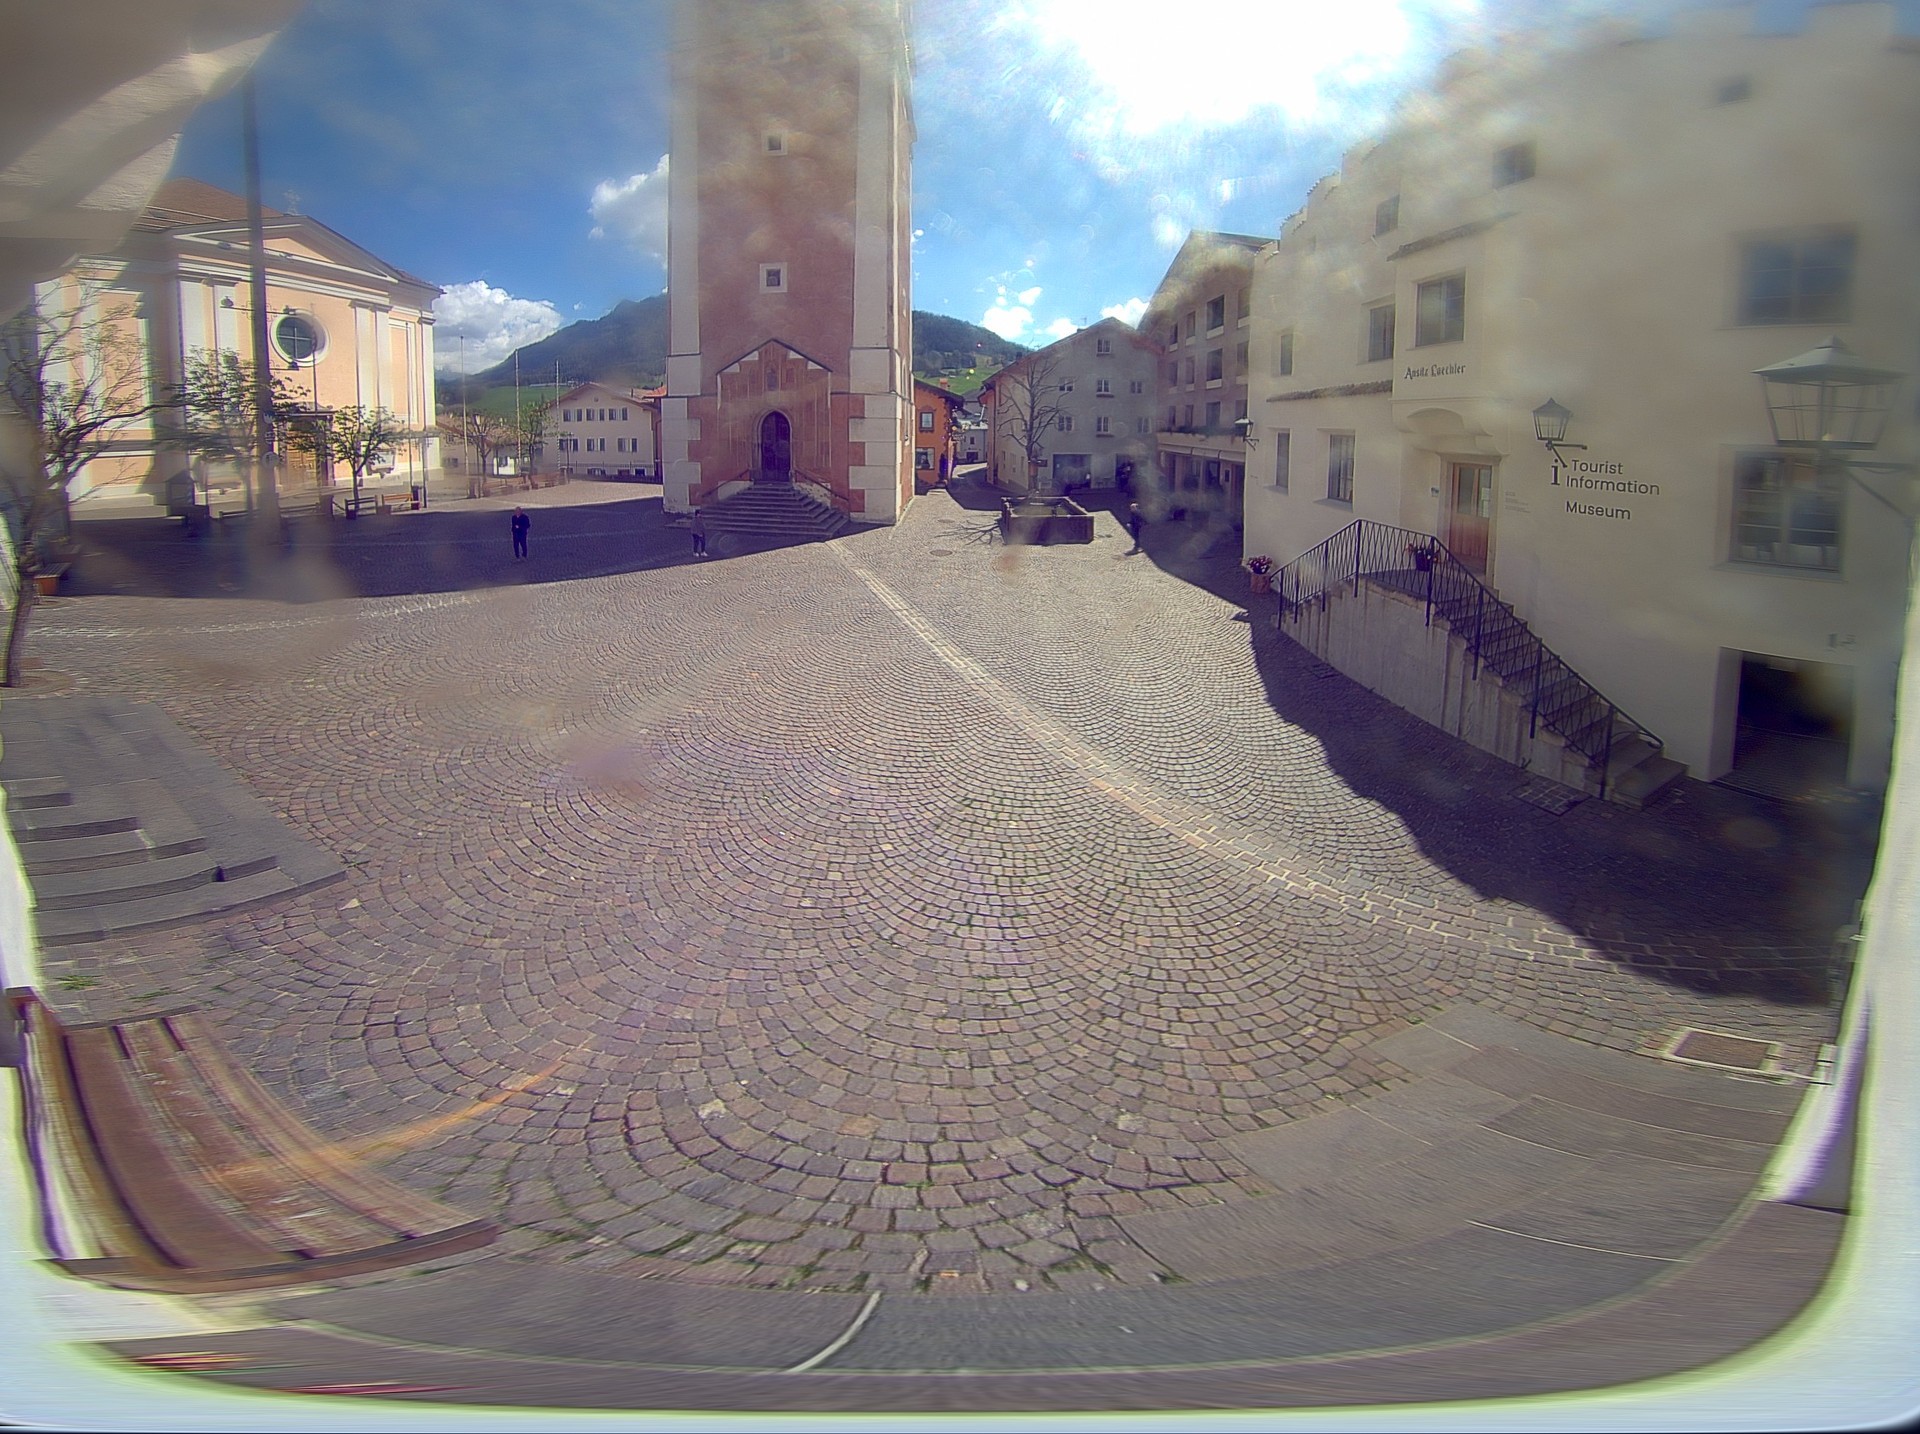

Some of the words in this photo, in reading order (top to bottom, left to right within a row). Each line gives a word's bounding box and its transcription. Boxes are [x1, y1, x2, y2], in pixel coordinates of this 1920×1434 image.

[1571, 459, 1623, 475] Tourist
[1566, 475, 1660, 495] Information
[1565, 501, 1631, 520] Museum
